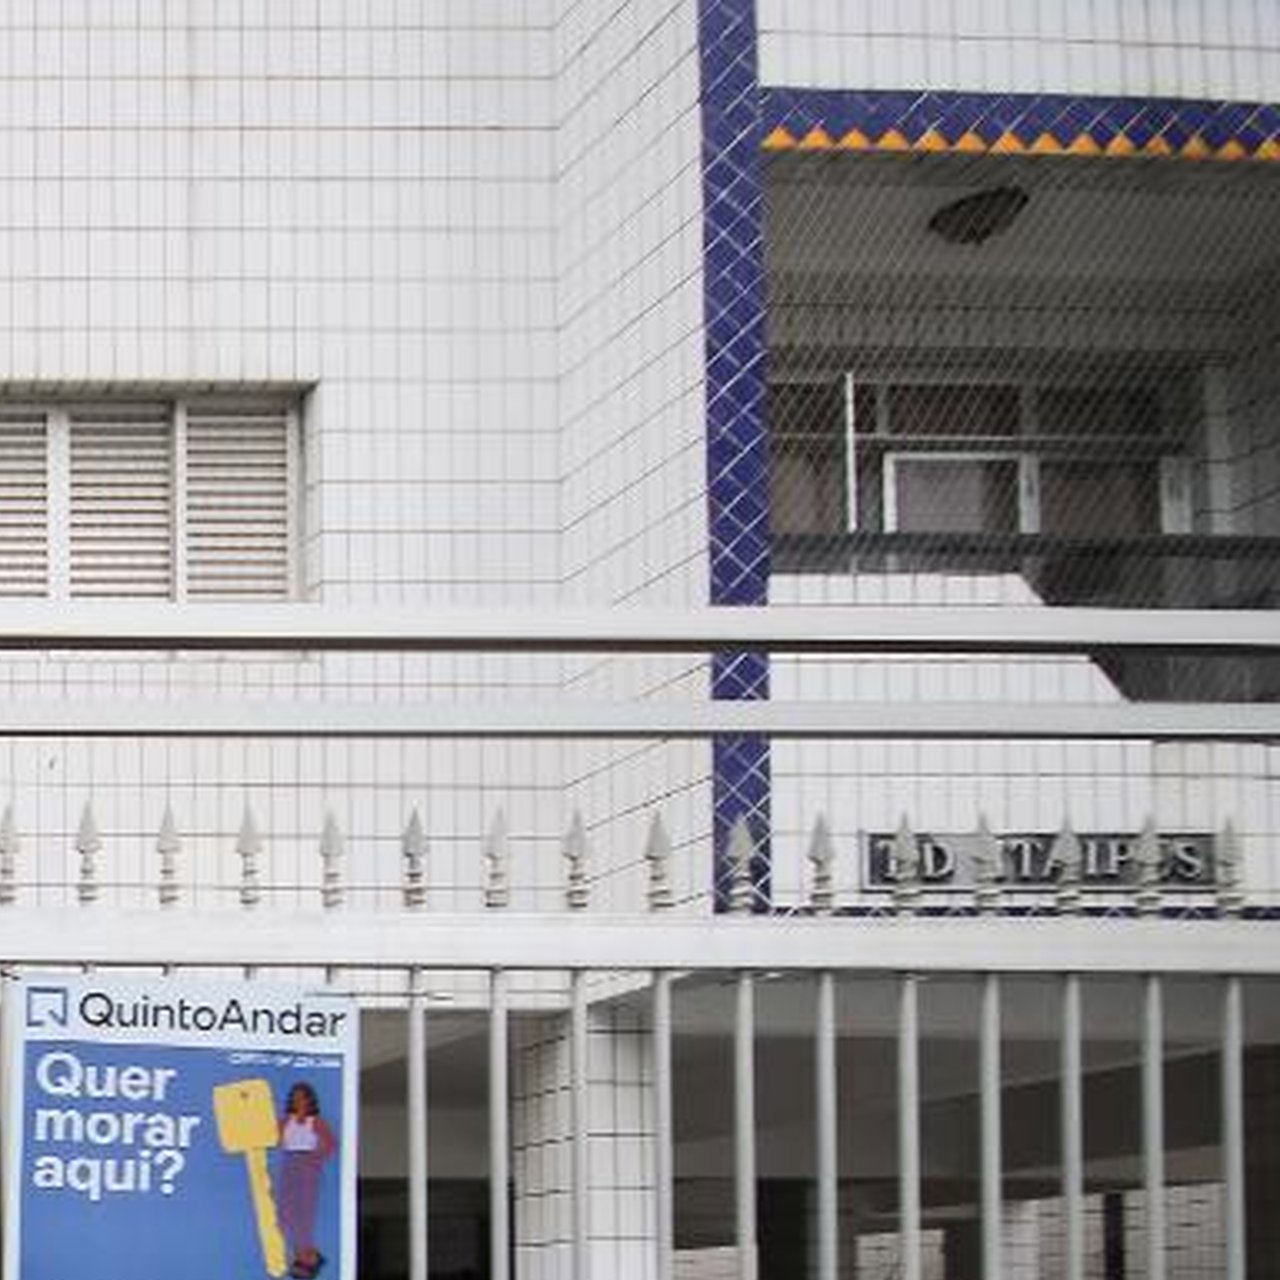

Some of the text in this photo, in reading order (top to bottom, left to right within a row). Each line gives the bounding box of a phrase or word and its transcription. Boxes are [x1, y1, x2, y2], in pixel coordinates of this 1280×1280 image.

[78, 991, 347, 1038] QuintoAndar
[36, 1052, 177, 1100] Quer
[34, 1107, 200, 1148] morar
[33, 1151, 185, 1201] aqui?
